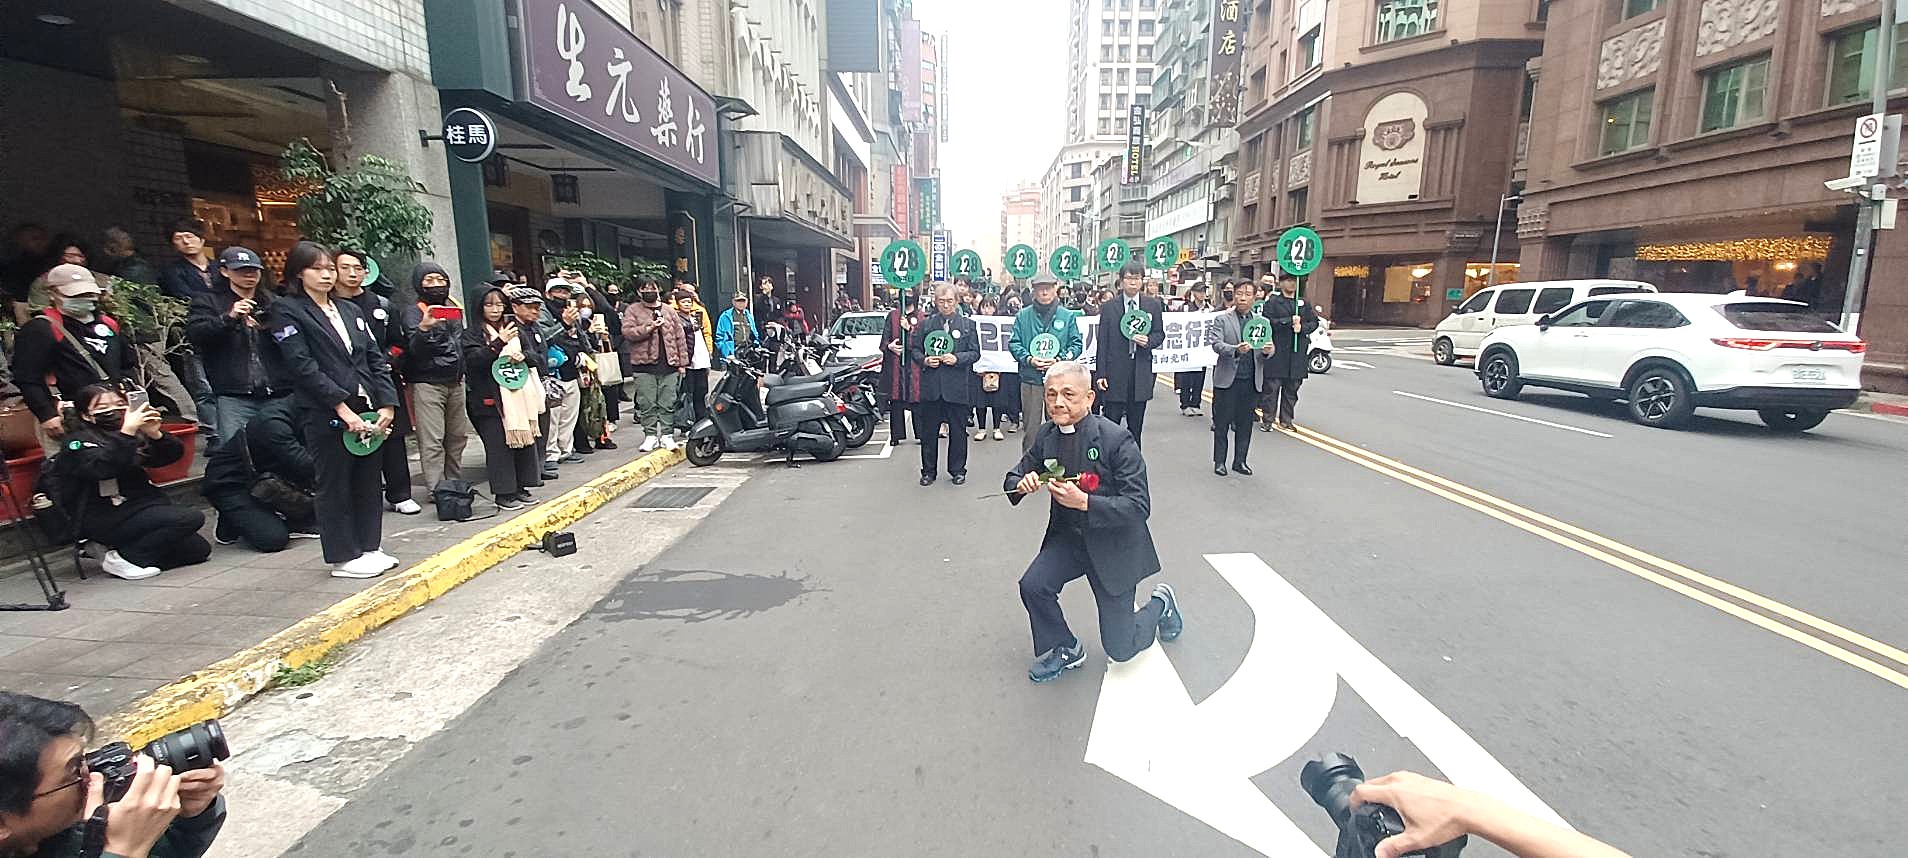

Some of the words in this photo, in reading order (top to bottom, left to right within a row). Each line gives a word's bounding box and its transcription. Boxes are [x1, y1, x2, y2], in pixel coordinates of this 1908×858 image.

[446, 125, 488, 145] 桂馬
[1131, 145, 1140, 176] HOTEL
[1364, 159, 1391, 170] Royal
[1378, 170, 1401, 180] Hotel
[1151, 242, 1175, 259] 228
[1284, 238, 1315, 260] 228
[888, 249, 919, 272] 228
[956, 256, 977, 274] 228
[1013, 252, 1033, 268] 228
[1057, 255, 1078, 271] 228
[1126, 315, 1146, 332] 228
[1249, 326, 1266, 338] 228
[931, 336, 949, 350] 228
[1036, 338, 1054, 350] 228
[499, 361, 519, 383] 228
